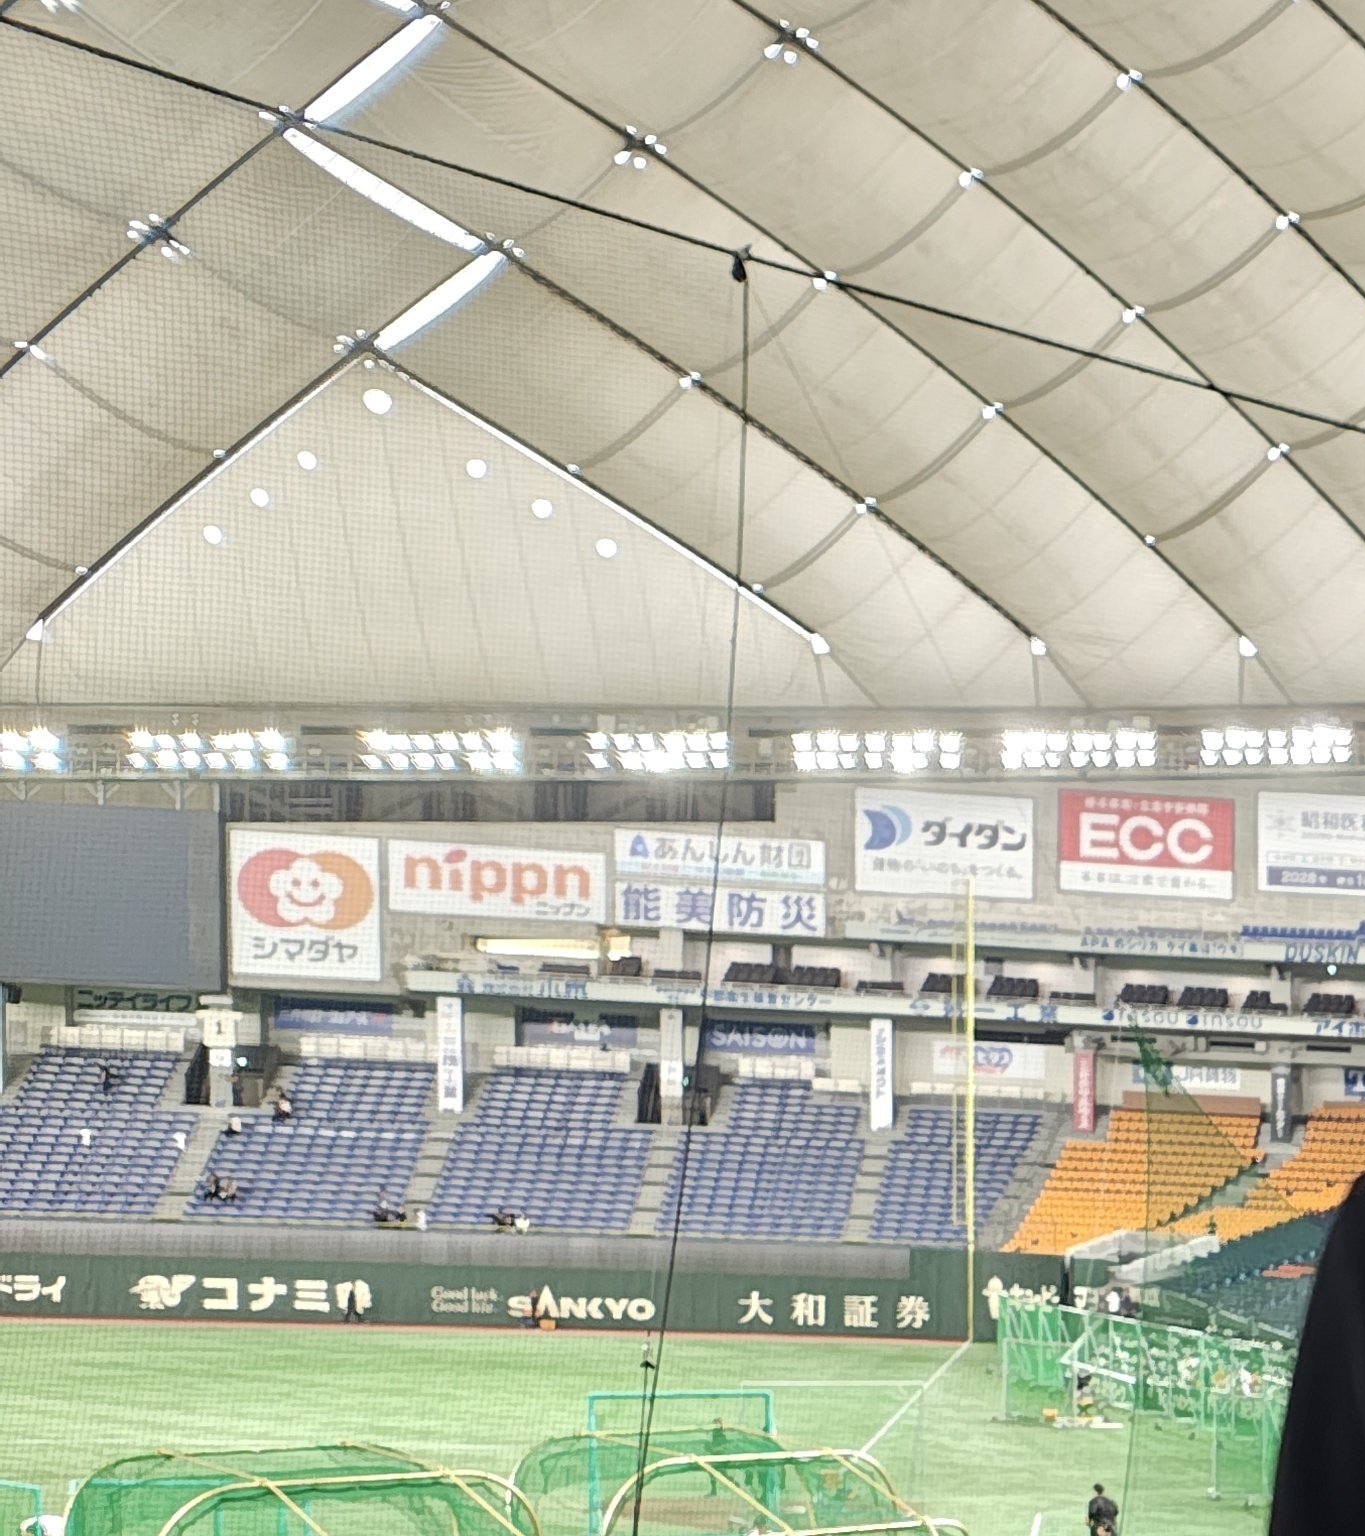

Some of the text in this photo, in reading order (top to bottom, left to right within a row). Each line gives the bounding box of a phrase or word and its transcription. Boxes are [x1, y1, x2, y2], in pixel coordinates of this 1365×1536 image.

[921, 817, 1027, 851] ダイダン
[1079, 812, 1214, 864] ECC
[654, 837, 812, 869] あんしん財団
[404, 848, 593, 906] nippn
[621, 883, 817, 932] 能美防災
[252, 936, 359, 963] シマダヤ
[1285, 946, 1358, 964] DUSKIN
[711, 1023, 808, 1050] SAISON
[507, 1285, 655, 1321] SANKYO
[738, 1292, 931, 1329] 大和証券
